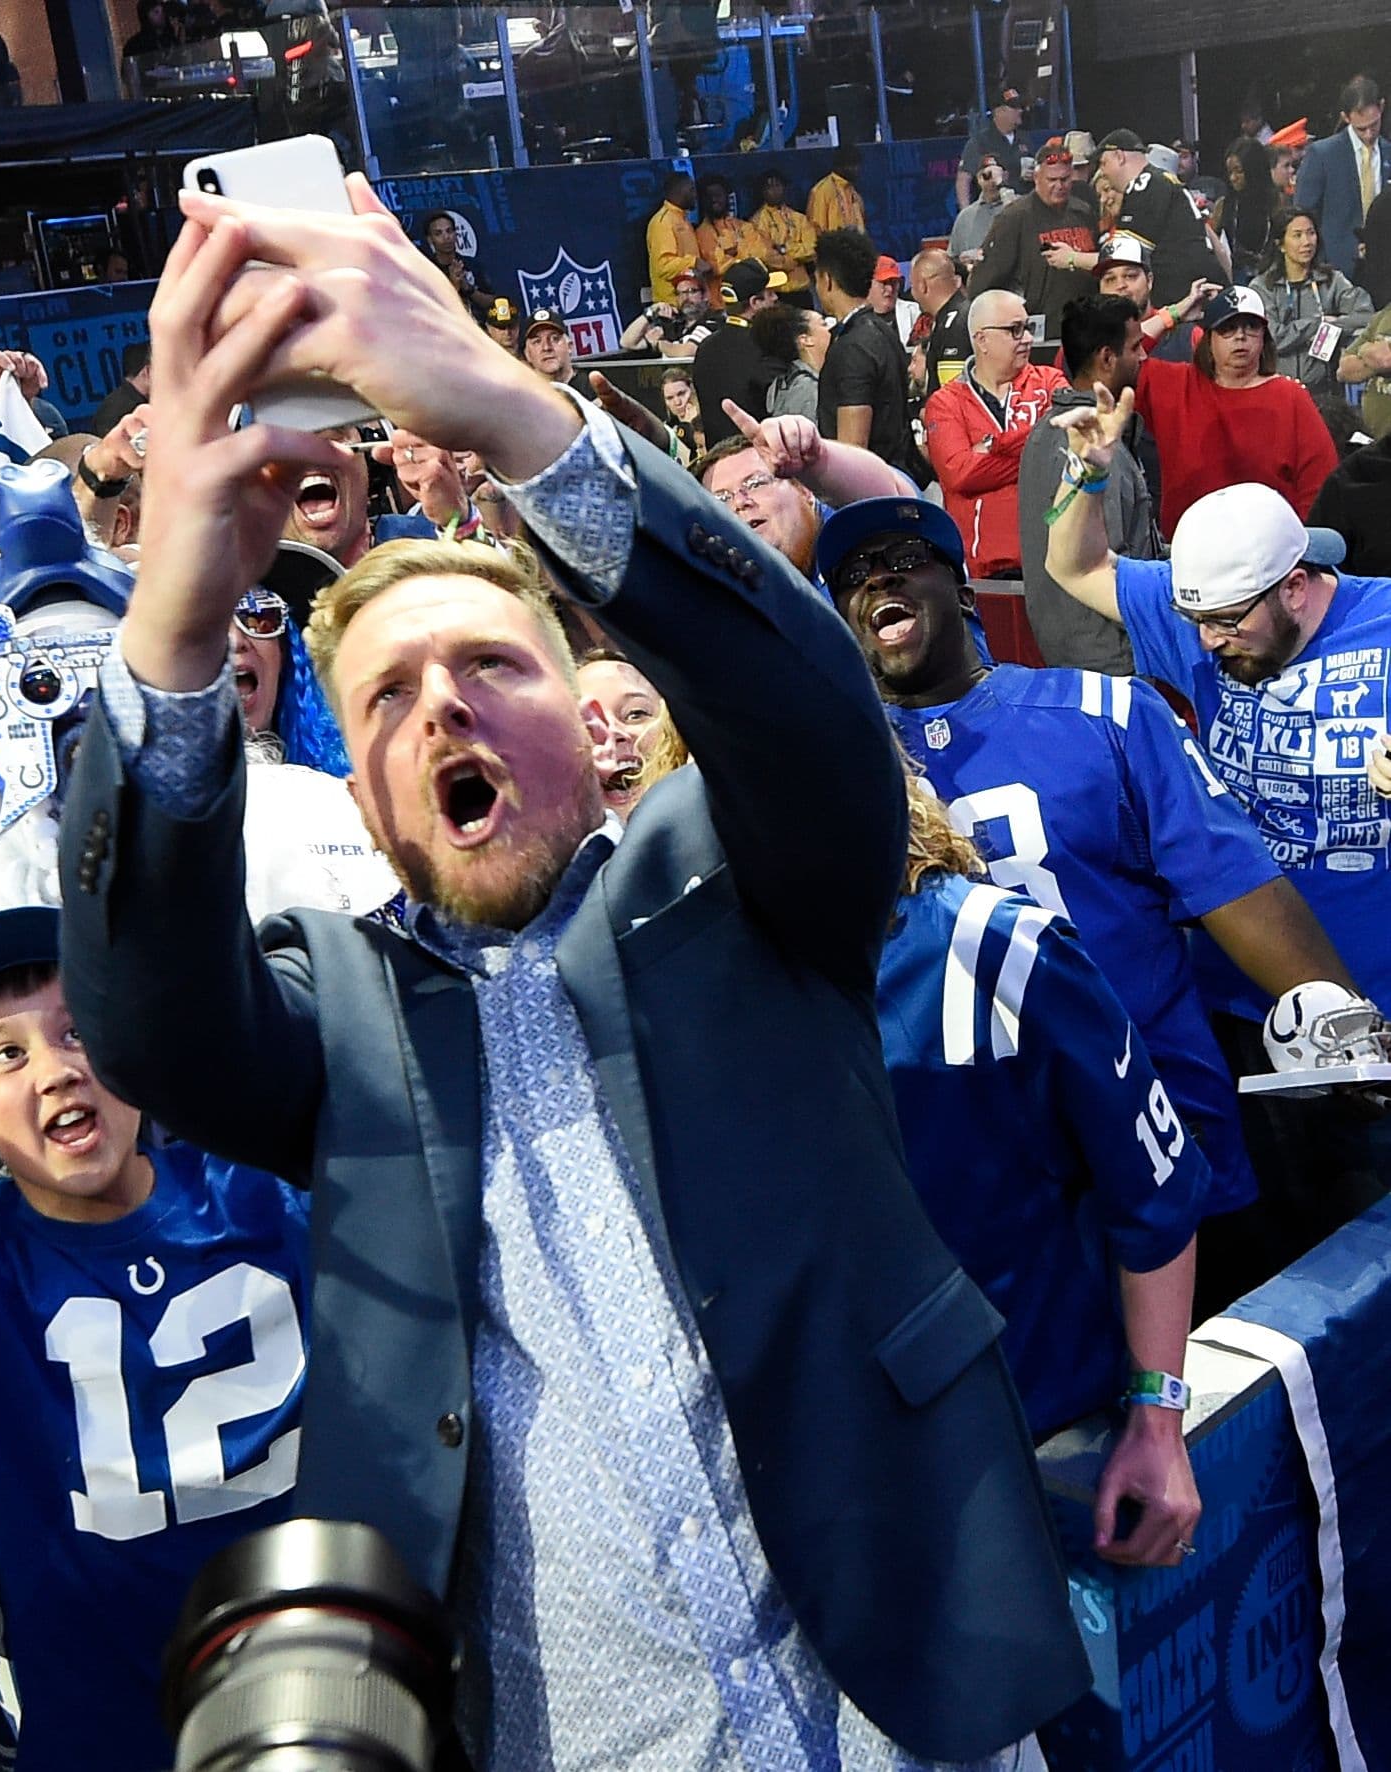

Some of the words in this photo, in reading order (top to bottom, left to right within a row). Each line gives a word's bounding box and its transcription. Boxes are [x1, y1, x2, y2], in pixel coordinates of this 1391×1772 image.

[52, 326, 89, 348] ON
[1326, 648, 1382, 670] MARLIN'S
[1263, 712, 1287, 727] OUR
[1261, 723, 1313, 758] XLI
[1341, 737, 1359, 759] 18
[1328, 823, 1381, 847] COLTS
[1135, 1079, 1185, 1187] 19
[44, 1261, 307, 1542] 12
[1120, 1600, 1217, 1760] COLTS
